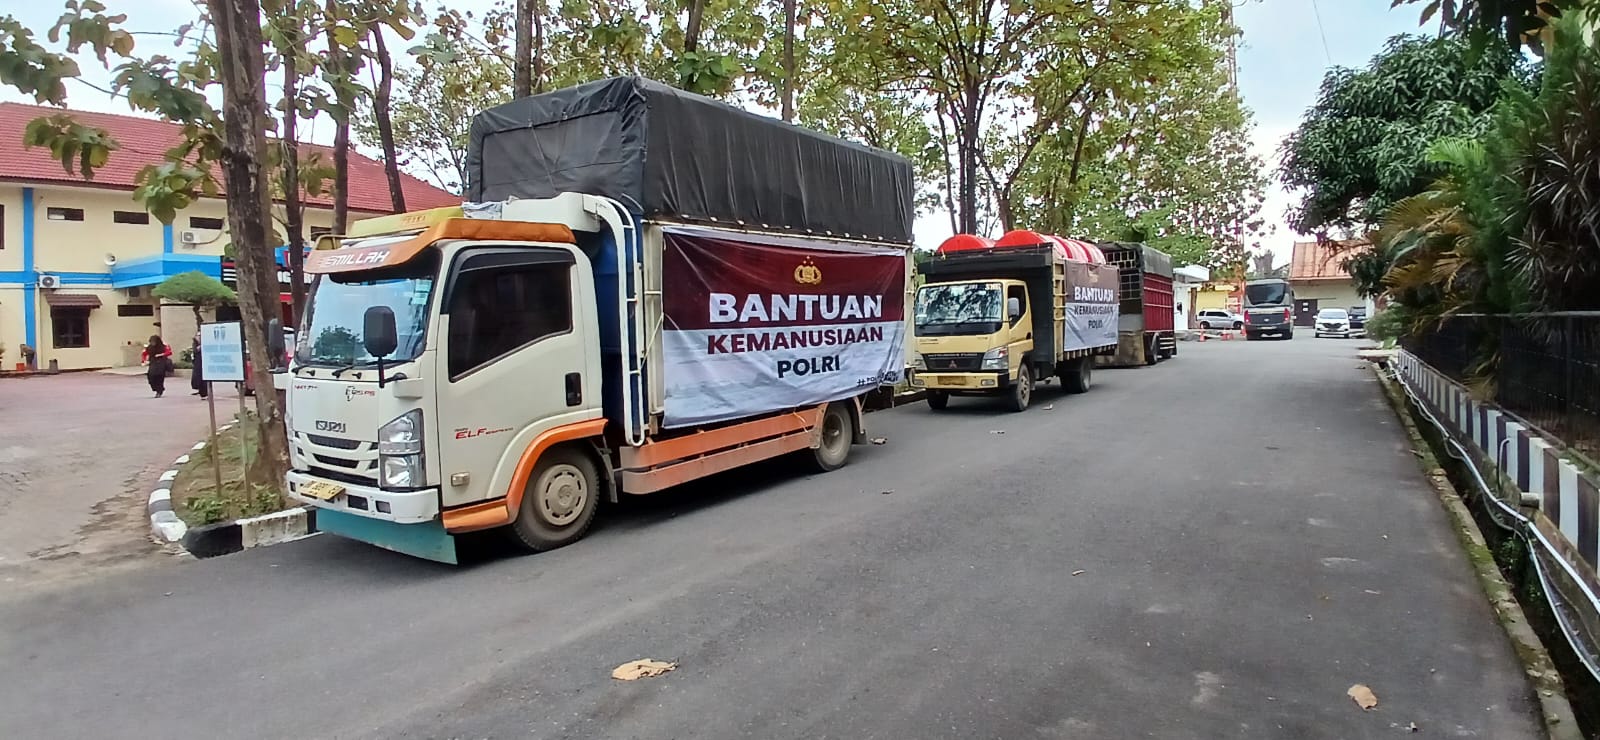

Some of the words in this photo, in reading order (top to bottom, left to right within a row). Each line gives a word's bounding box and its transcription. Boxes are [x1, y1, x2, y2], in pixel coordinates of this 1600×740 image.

[1074, 286, 1114, 302] BANTUAN
[709, 293, 883, 323] BANTUAN
[707, 326, 883, 355] KEMANUSIAAN
[777, 355, 840, 378] POLRI
[315, 420, 346, 433] ISUZU
[455, 428, 487, 439] ELF
